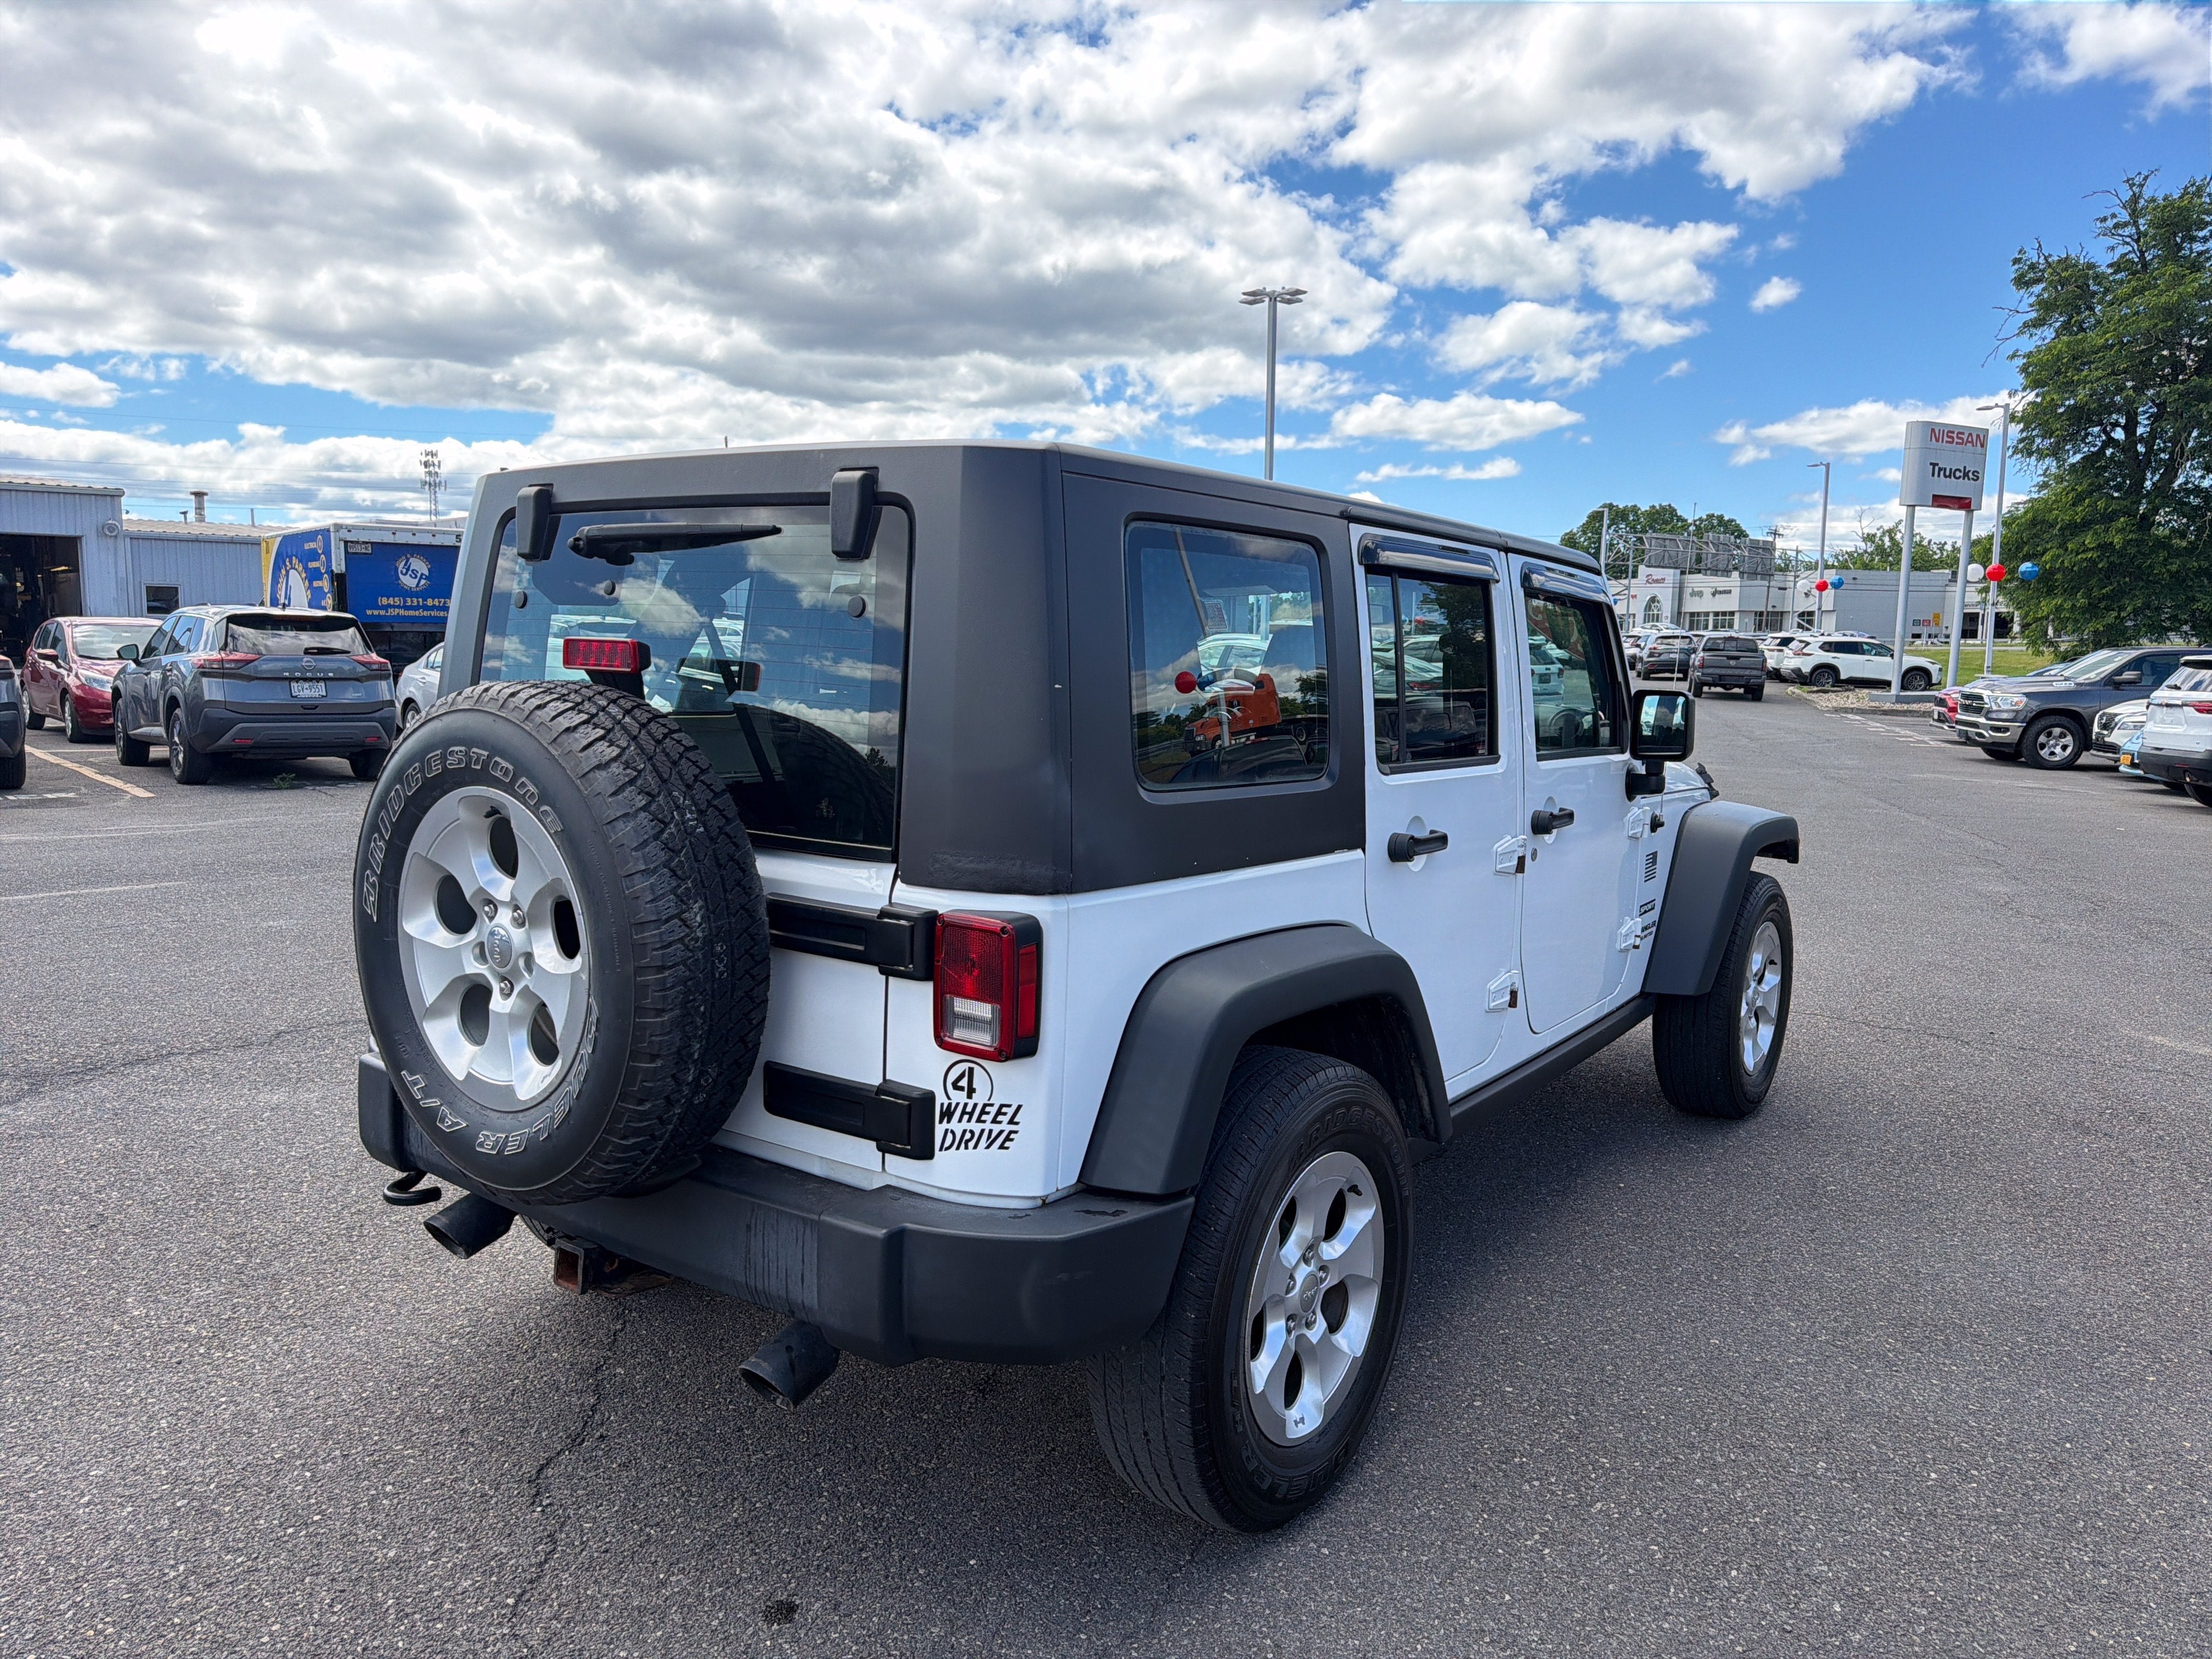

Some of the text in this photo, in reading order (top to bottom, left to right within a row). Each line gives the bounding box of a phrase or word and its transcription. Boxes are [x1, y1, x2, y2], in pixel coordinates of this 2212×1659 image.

[1929, 427, 1986, 448] NISSAN
[1929, 462, 1980, 482] Trucks
[455, 534, 462, 543] 5
[395, 556, 406, 568] JOHN
[414, 554, 431, 569] PARKER
[276, 565, 286, 604] JOHN
[292, 556, 311, 602] PARKER
[400, 559, 429, 587] JSP
[1645, 573, 1666, 585] Romeo
[398, 579, 431, 591] HOME SERVICES
[1689, 588, 1704, 599] Jeep
[377, 596, 450, 607] (845) 331-8473
[362, 746, 565, 923] BRIDGESTONE
[1640, 902, 1655, 912] SPORT
[1641, 920, 1656, 932] ANGLER
[476, 996, 599, 1155] DUELER
[951, 1066, 977, 1100] 4
[400, 1069, 469, 1132] A/T
[938, 1102, 1023, 1126] WHEEL
[938, 1128, 1019, 1152] DRIVE
[1289, 1105, 1409, 1199] BRIDGESTONE
[1242, 1436, 1350, 1499] DUELER
